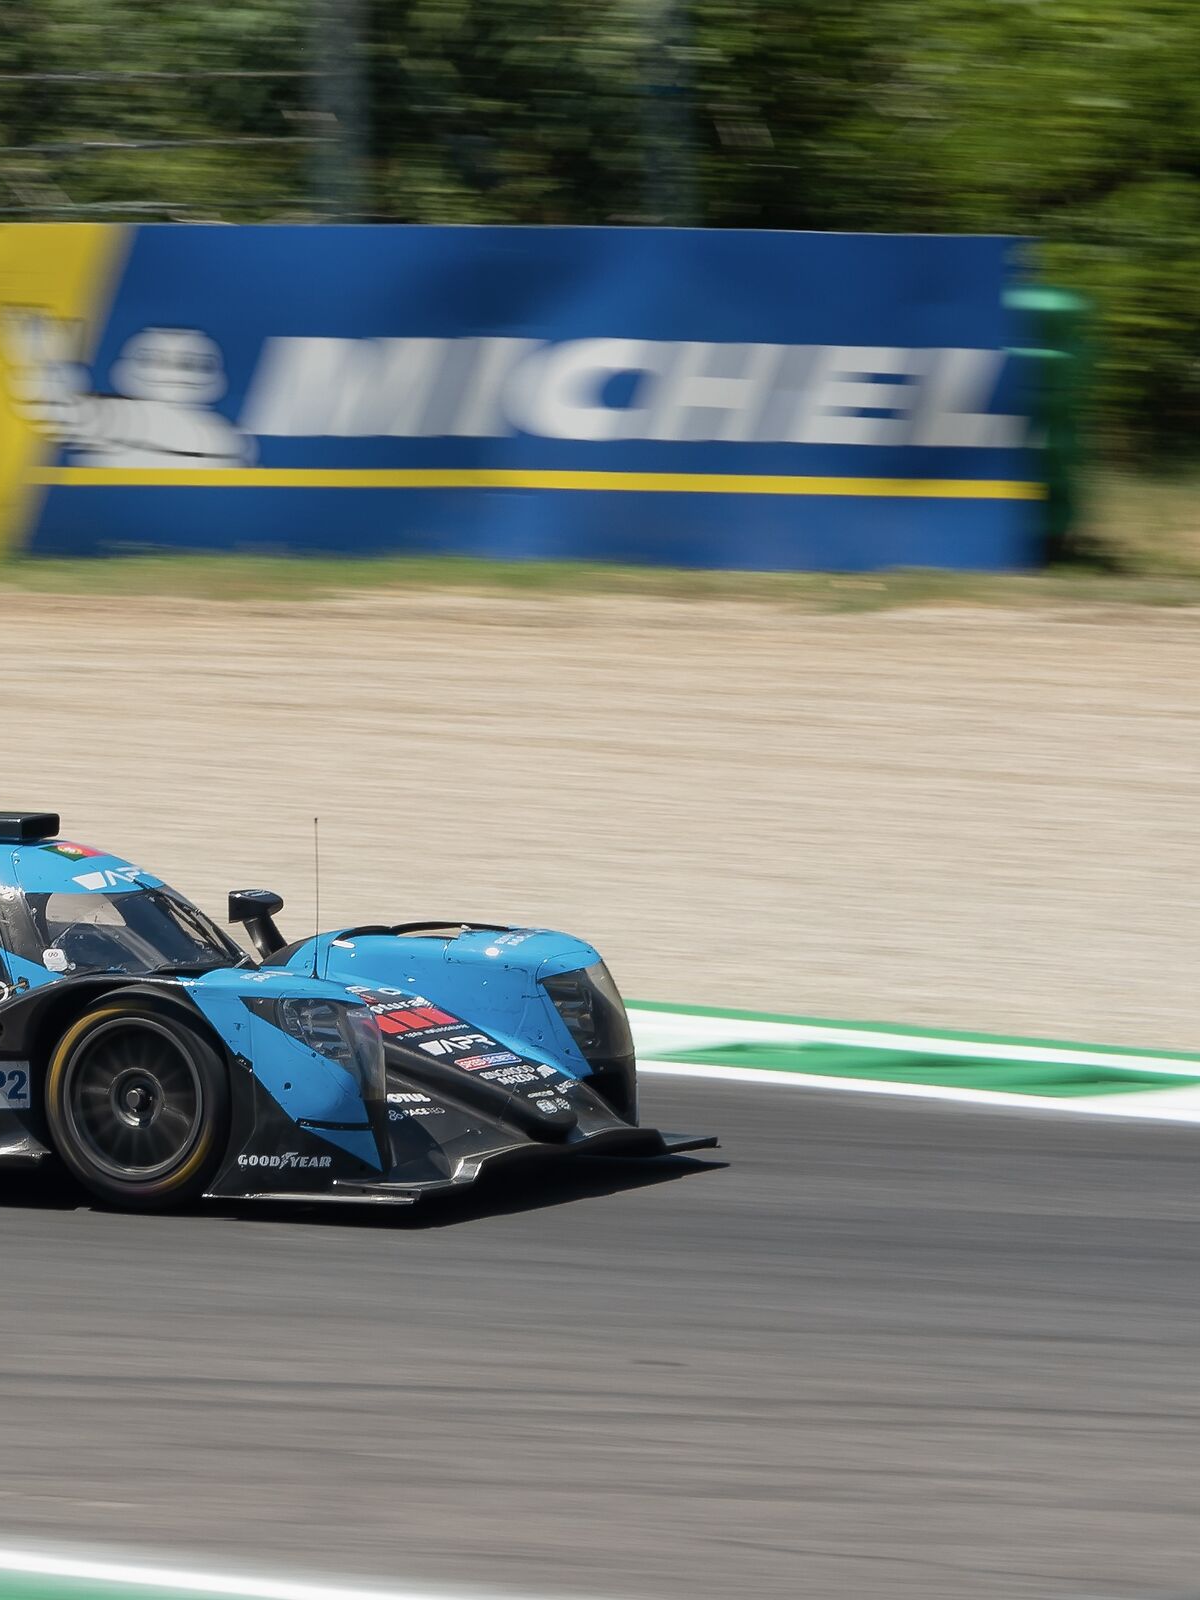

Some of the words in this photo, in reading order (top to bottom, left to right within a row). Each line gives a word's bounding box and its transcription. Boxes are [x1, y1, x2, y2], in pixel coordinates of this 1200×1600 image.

[496, 1072, 540, 1086] MAZDA
[386, 1093, 432, 1103] OTUL
[238, 1151, 333, 1169] GOODYEAR
